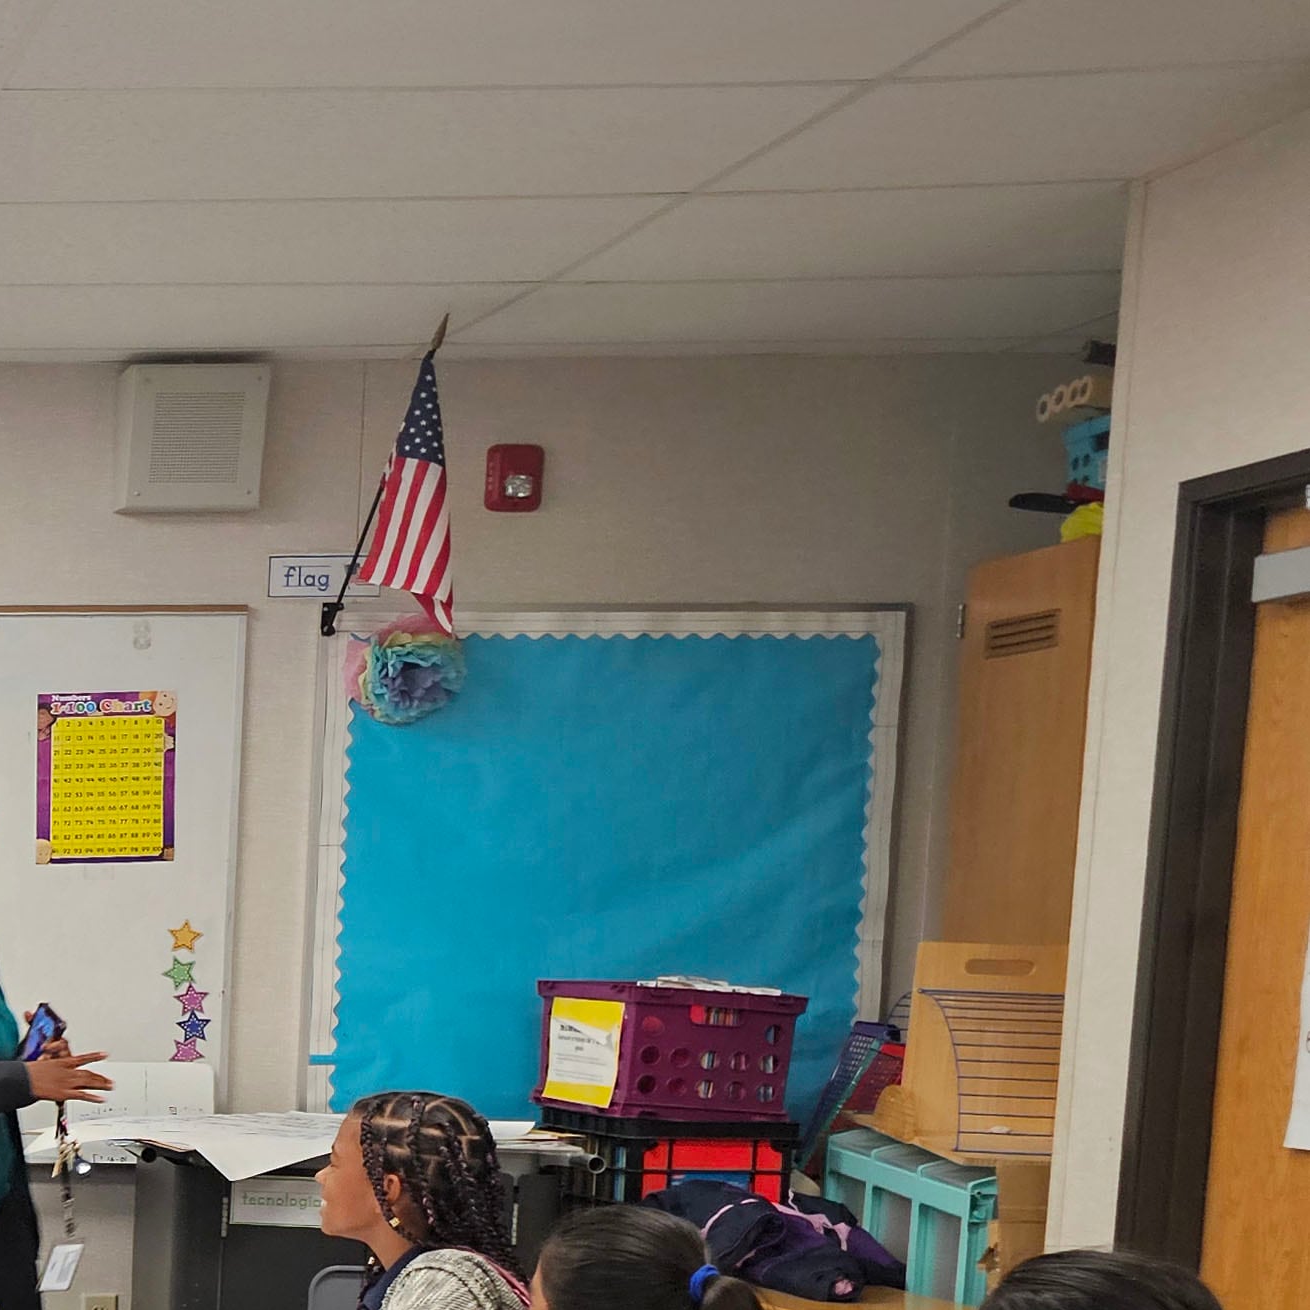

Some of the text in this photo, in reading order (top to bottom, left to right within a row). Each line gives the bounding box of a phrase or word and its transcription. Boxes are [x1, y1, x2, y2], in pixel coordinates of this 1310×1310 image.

[284, 566, 330, 592] flag
[50, 698, 152, 714] 1-100 Chart
